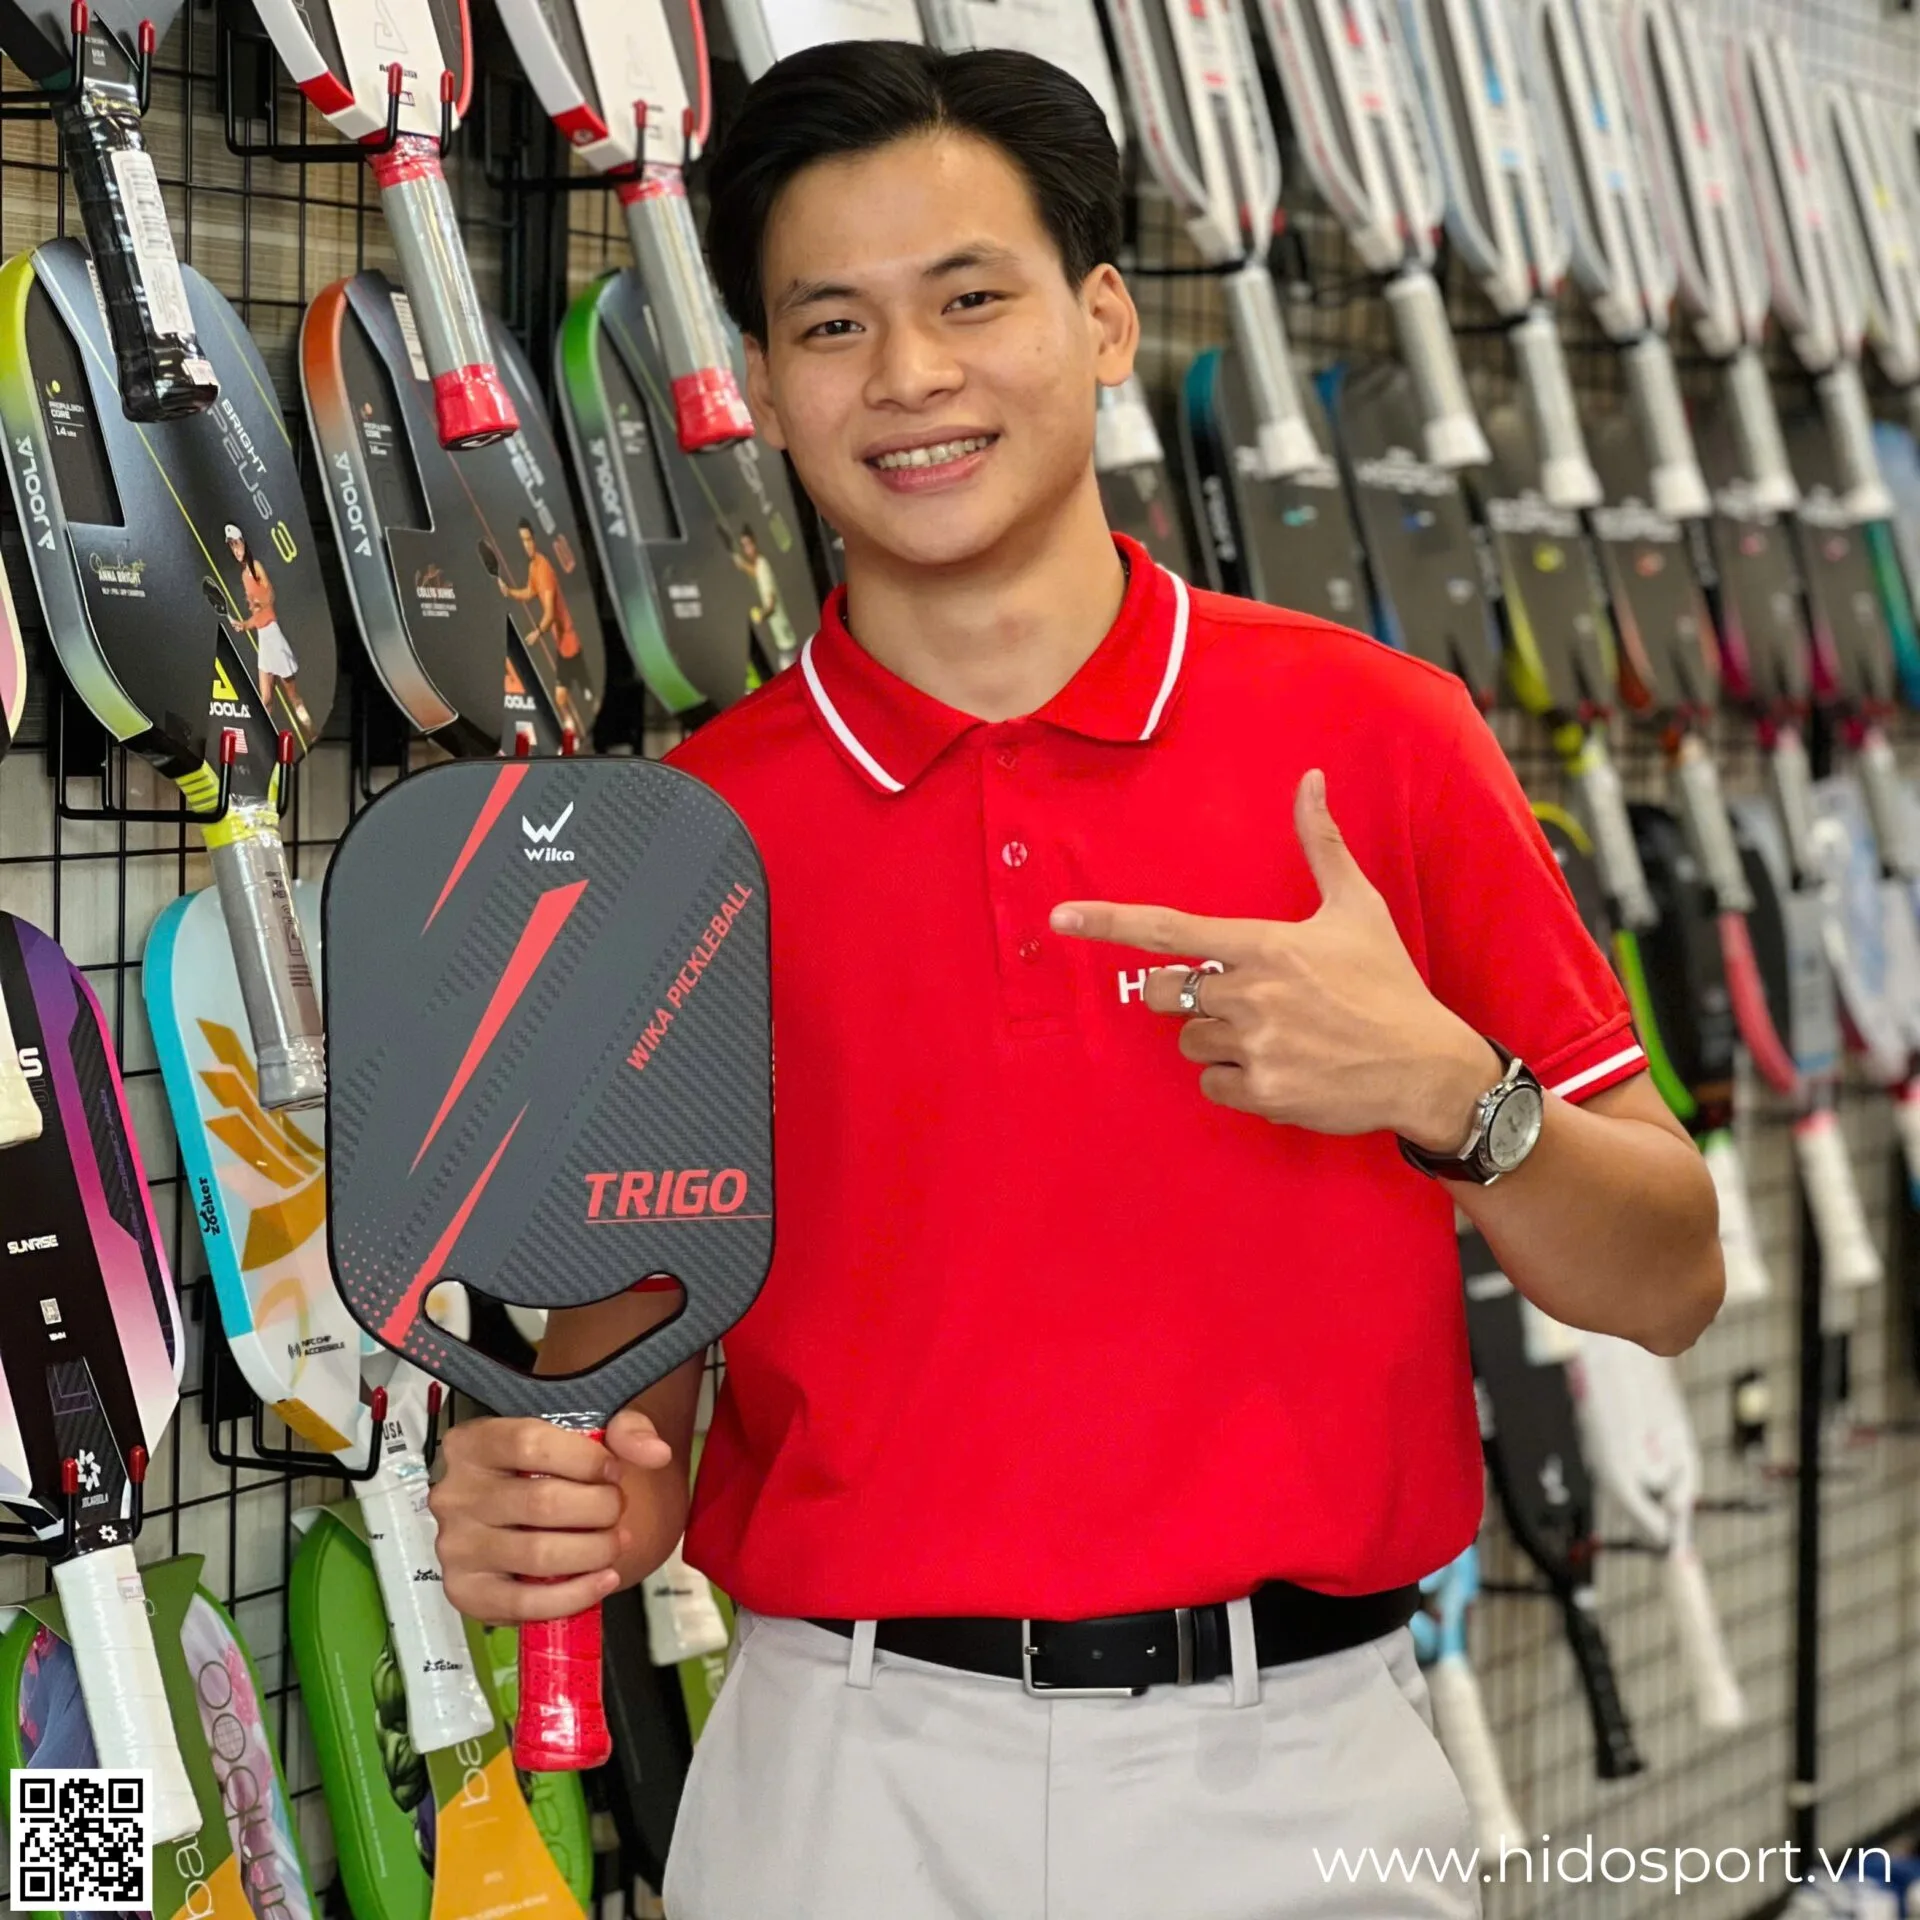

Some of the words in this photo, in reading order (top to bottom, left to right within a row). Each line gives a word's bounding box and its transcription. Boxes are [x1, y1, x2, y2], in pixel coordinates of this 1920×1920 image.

[50, 408, 71, 420] CORE
[221, 398, 268, 473] BRIGHT
[17, 434, 51, 528] JOOLA
[334, 449, 368, 536] JOOLA
[208, 701, 252, 719] JOOLA
[523, 846, 576, 862] Wika
[625, 1006, 675, 1072] WIKA
[665, 881, 754, 1009] PICKLEBALL
[584, 1168, 749, 1218] TRIGO
[6, 1234, 60, 1255] SUNRISE
[382, 1420, 404, 1440] USA
